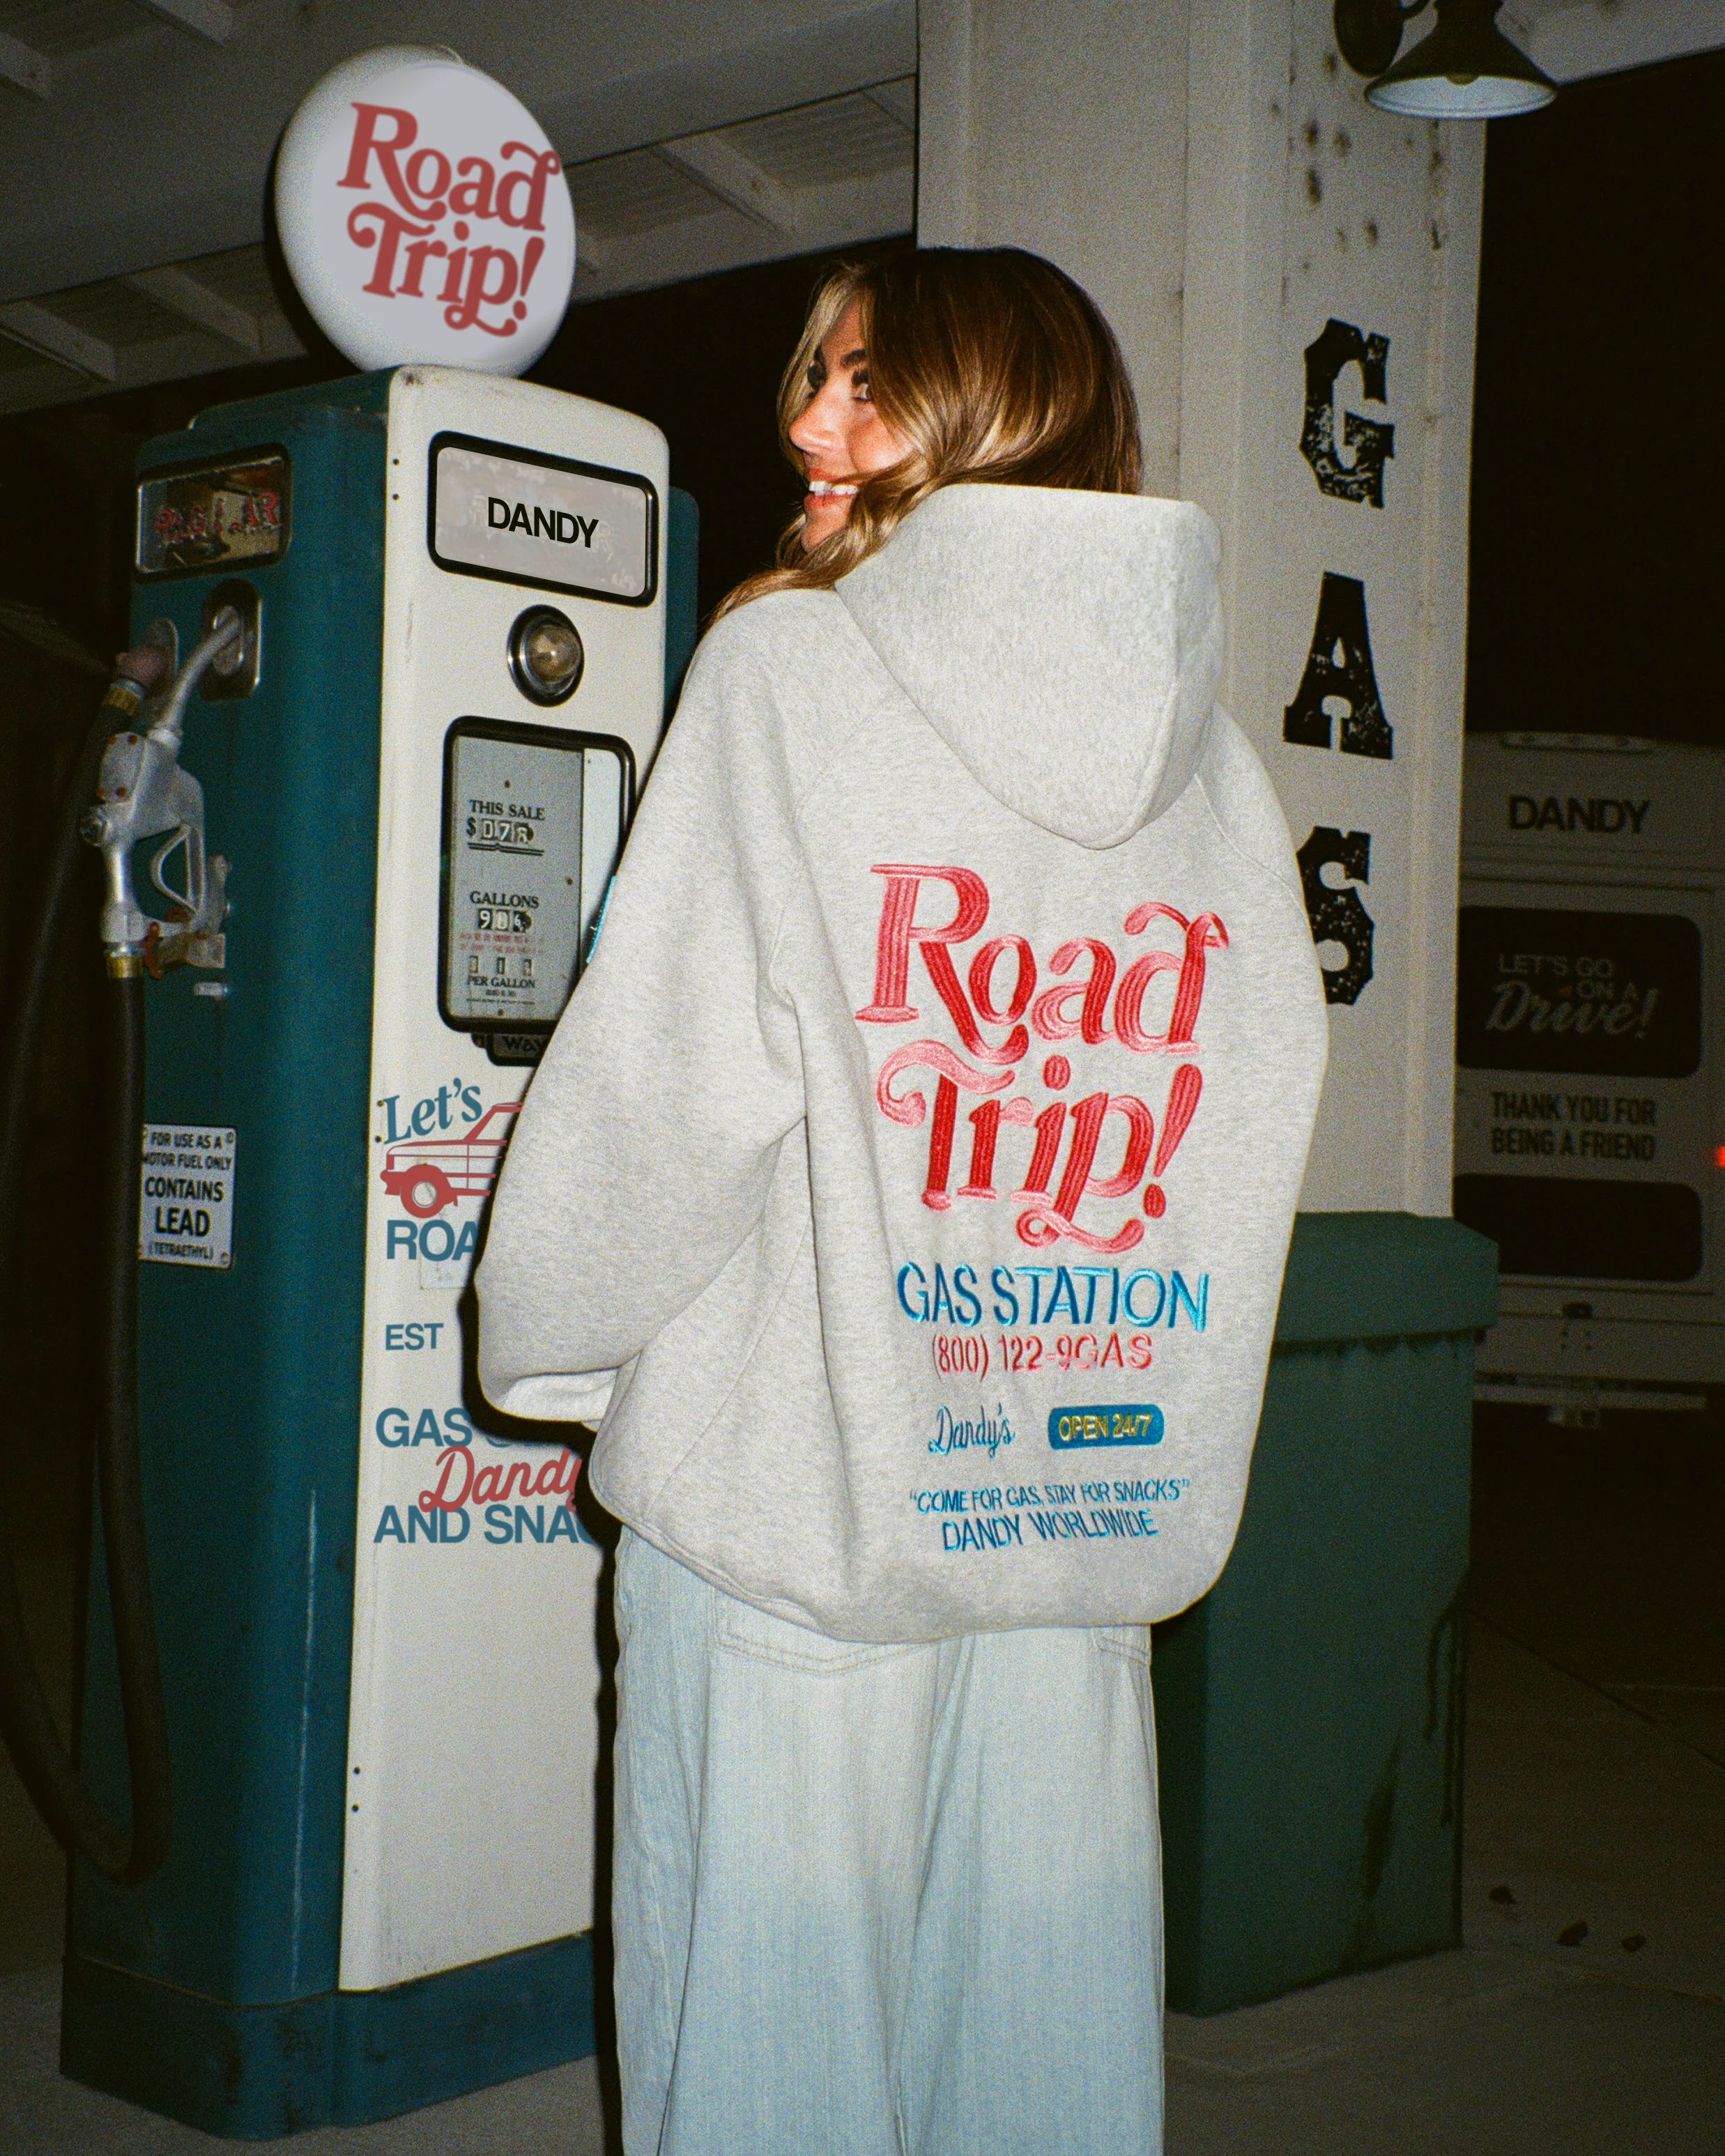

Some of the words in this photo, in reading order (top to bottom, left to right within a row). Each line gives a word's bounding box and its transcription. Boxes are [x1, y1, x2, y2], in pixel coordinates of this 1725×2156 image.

[337, 101, 561, 231] Road
[347, 201, 545, 337] Trip!
[488, 496, 599, 548] DANDY
[1284, 317, 1395, 1006] GAS
[470, 799, 504, 815] THIS
[509, 804, 546, 821] SALE
[1508, 794, 1650, 835] DANDY
[470, 891, 539, 909] GALLONS
[467, 975, 489, 987] PER
[491, 976, 535, 989] GALLON
[855, 863, 1229, 1065] Road
[1577, 979, 1615, 1001] ON
[1622, 981, 1639, 1001] A
[1485, 980, 1659, 1039] Drive!
[383, 1077, 482, 1145] Let's
[1492, 1091, 1560, 1119] THANK
[1566, 1094, 1608, 1122] YOU
[1615, 1097, 1656, 1125] FOR
[151, 1131, 171, 1146] FOR
[174, 1132, 194, 1148] USE
[196, 1134, 212, 1149] AS
[214, 1136, 223, 1150] A
[876, 1039, 1203, 1254] Trip!
[1491, 1127, 1554, 1155] BEING
[1559, 1129, 1575, 1157] A
[1579, 1130, 1656, 1161] FRIEND
[178, 1153, 204, 1169] FUEL
[205, 1155, 233, 1171] ONLY
[144, 1176, 225, 1203] CONTAINS
[155, 1206, 211, 1237] LEAD
[897, 1262, 982, 1327] GAS
[991, 1265, 1209, 1332] STATION
[385, 1323, 443, 1350] EST
[932, 1333, 989, 1382] (800)
[376, 1408, 473, 1447] GAS
[928, 1402, 1015, 1458] Dandy's
[1058, 1415, 1109, 1441] OPEN
[1112, 1413, 1151, 1438] 24/7
[972, 1486, 1003, 1511] FOR
[1045, 1484, 1076, 1505] STAY
[1080, 1481, 1110, 1504] FOR
[374, 1505, 470, 1543] AND
[942, 1513, 1025, 1553] DANDY
[1027, 1507, 1160, 1542] WORLDWIDE
